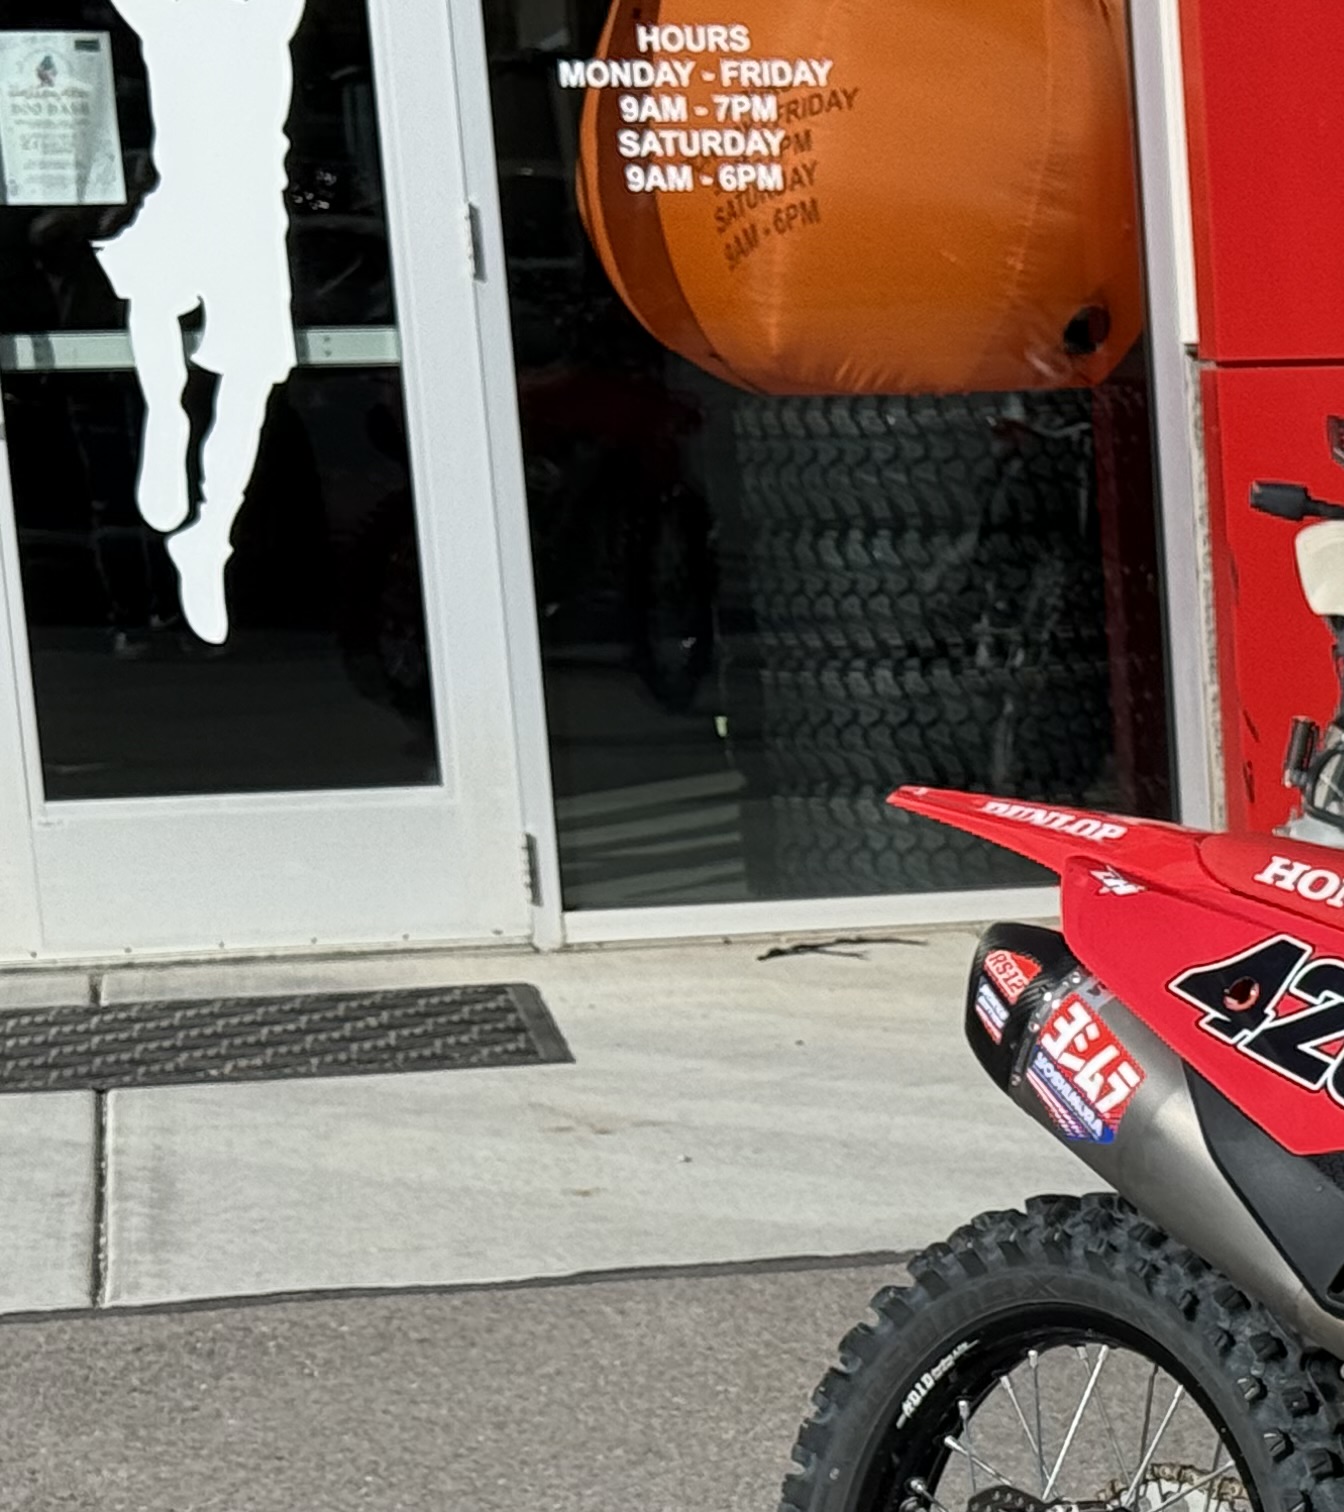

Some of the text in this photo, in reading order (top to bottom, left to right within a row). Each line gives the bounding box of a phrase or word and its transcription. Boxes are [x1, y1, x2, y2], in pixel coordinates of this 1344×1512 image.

[637, 23, 751, 53] HOURS
[557, 58, 696, 88] MONDAY
[720, 58, 834, 88] FRIDAY
[618, 93, 688, 123] 9AM
[712, 93, 779, 123] 7PM
[616, 128, 787, 158] SATURDAY
[624, 163, 695, 193] 9AM
[718, 163, 785, 193] 6PM
[977, 801, 1128, 841] DUNLOP
[1040, 1001, 1141, 1114] ヨシムラ
